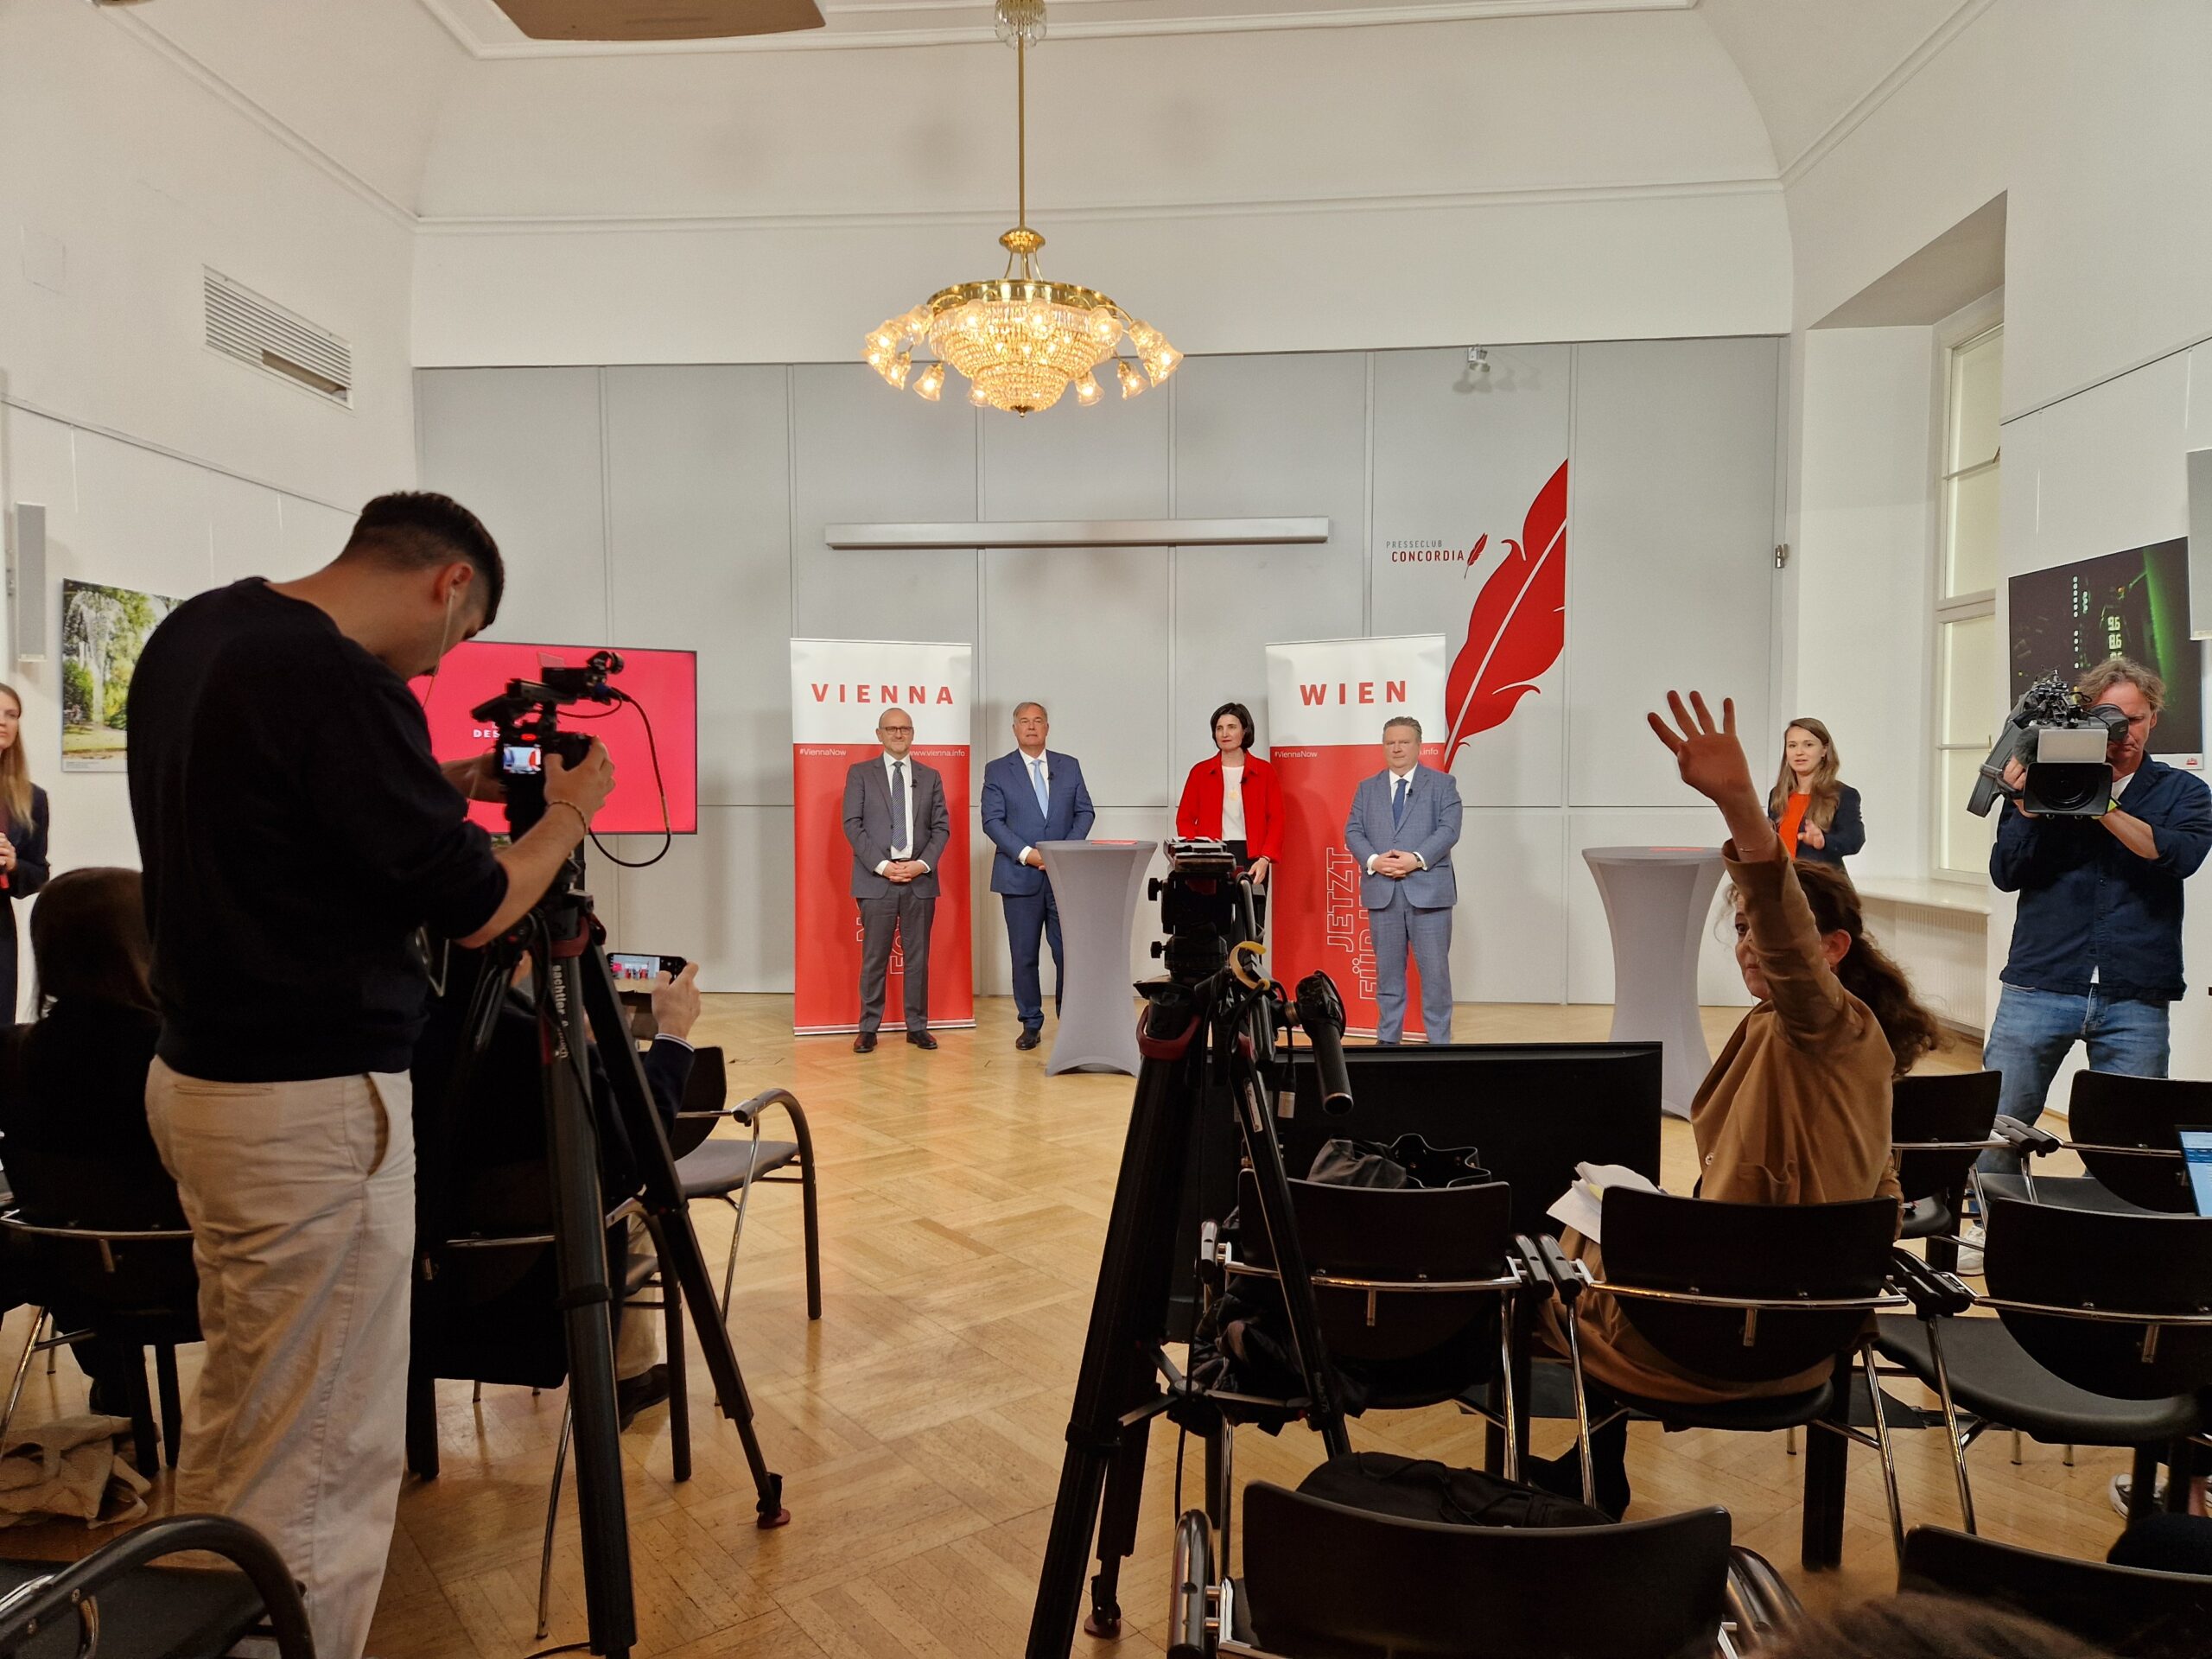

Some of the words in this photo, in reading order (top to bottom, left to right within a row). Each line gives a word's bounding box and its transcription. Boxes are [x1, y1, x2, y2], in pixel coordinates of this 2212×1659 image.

[1386, 540, 1442, 549] PRESSECLUB
[1391, 550, 1464, 563] CONCORDIA
[810, 683, 954, 704] VIENNA
[1300, 680, 1406, 706] WIEN
[1326, 847, 1354, 952] JETZT
